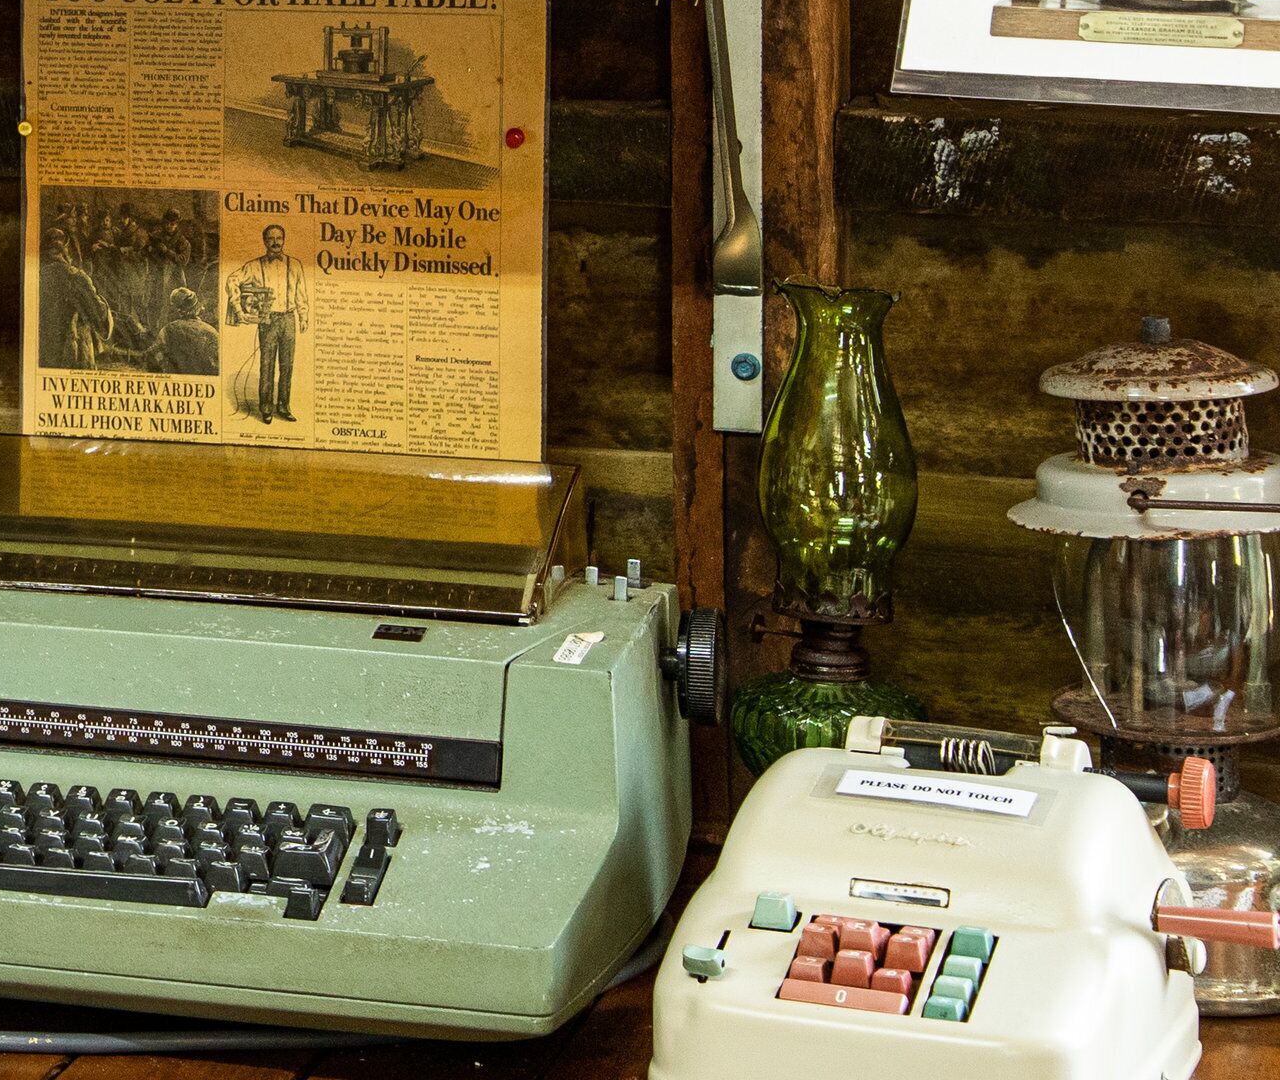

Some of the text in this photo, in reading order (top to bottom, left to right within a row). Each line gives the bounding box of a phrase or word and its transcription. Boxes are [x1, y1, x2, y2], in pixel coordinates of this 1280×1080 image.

[224, 192, 499, 227] Claims That Device May One
[319, 223, 467, 252] Day Be Mobile
[317, 249, 498, 279] Quickly Dismissed.
[42, 376, 215, 398] INVENTOR REWARDED
[51, 393, 205, 415] WITH REMARKABLY
[38, 411, 218, 436] SMALL PHONE NUMBER.
[332, 427, 387, 438] OBSTACLE
[860, 780, 1013, 804] PLEASE DO NOT TOUCH
